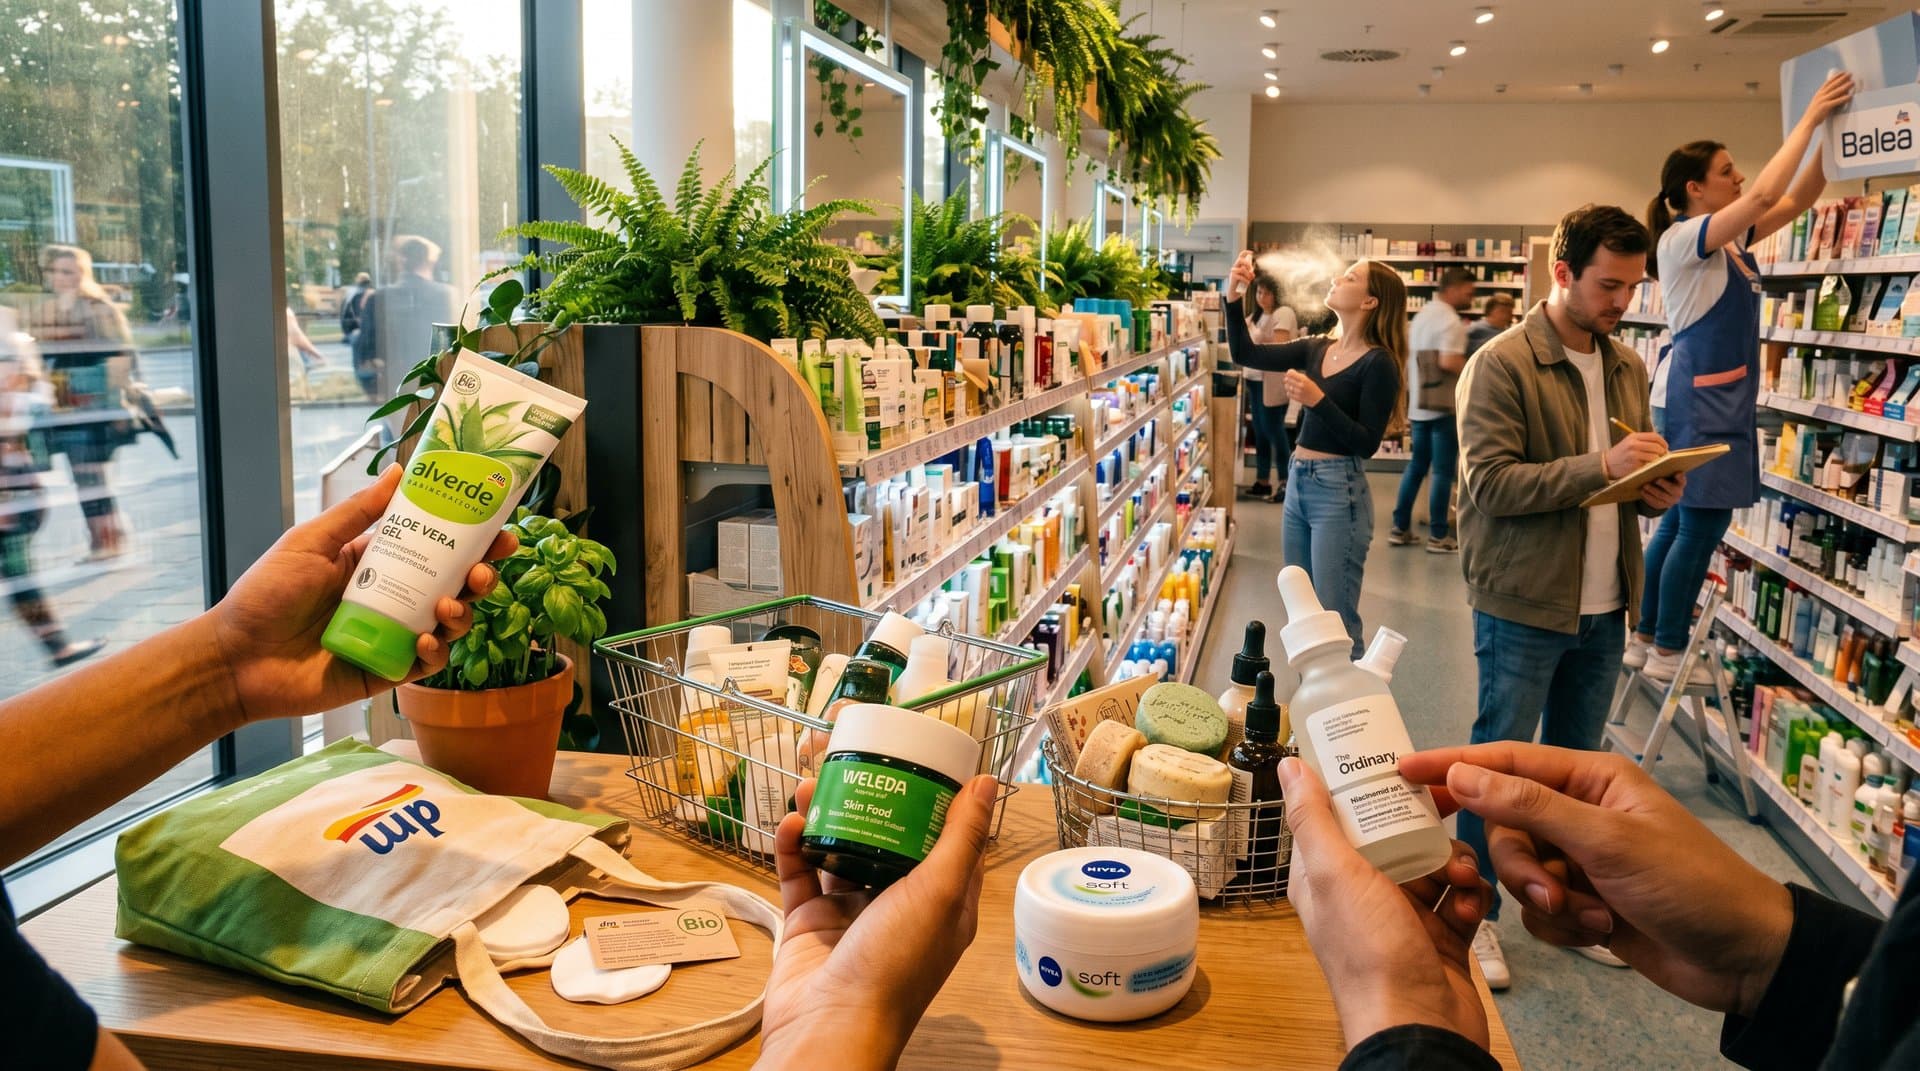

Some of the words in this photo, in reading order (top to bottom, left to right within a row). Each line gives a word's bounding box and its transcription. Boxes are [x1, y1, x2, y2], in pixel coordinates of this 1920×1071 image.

[1841, 128, 1912, 158] Balea
[412, 461, 494, 506] alverde
[382, 525, 402, 540] GEL
[387, 513, 420, 532] ALOE
[422, 524, 456, 550] VERA
[1336, 753, 1350, 763] The
[1339, 751, 1399, 775] Ordinary.
[843, 769, 907, 795] WELEDA
[843, 799, 864, 811] Skin
[867, 804, 892, 818] Food
[359, 800, 446, 855] dm
[1085, 881, 1129, 890] soft
[599, 920, 617, 928] dm
[683, 917, 718, 930] Bio
[1040, 965, 1059, 977] NIVEA
[1079, 971, 1121, 986] soft
